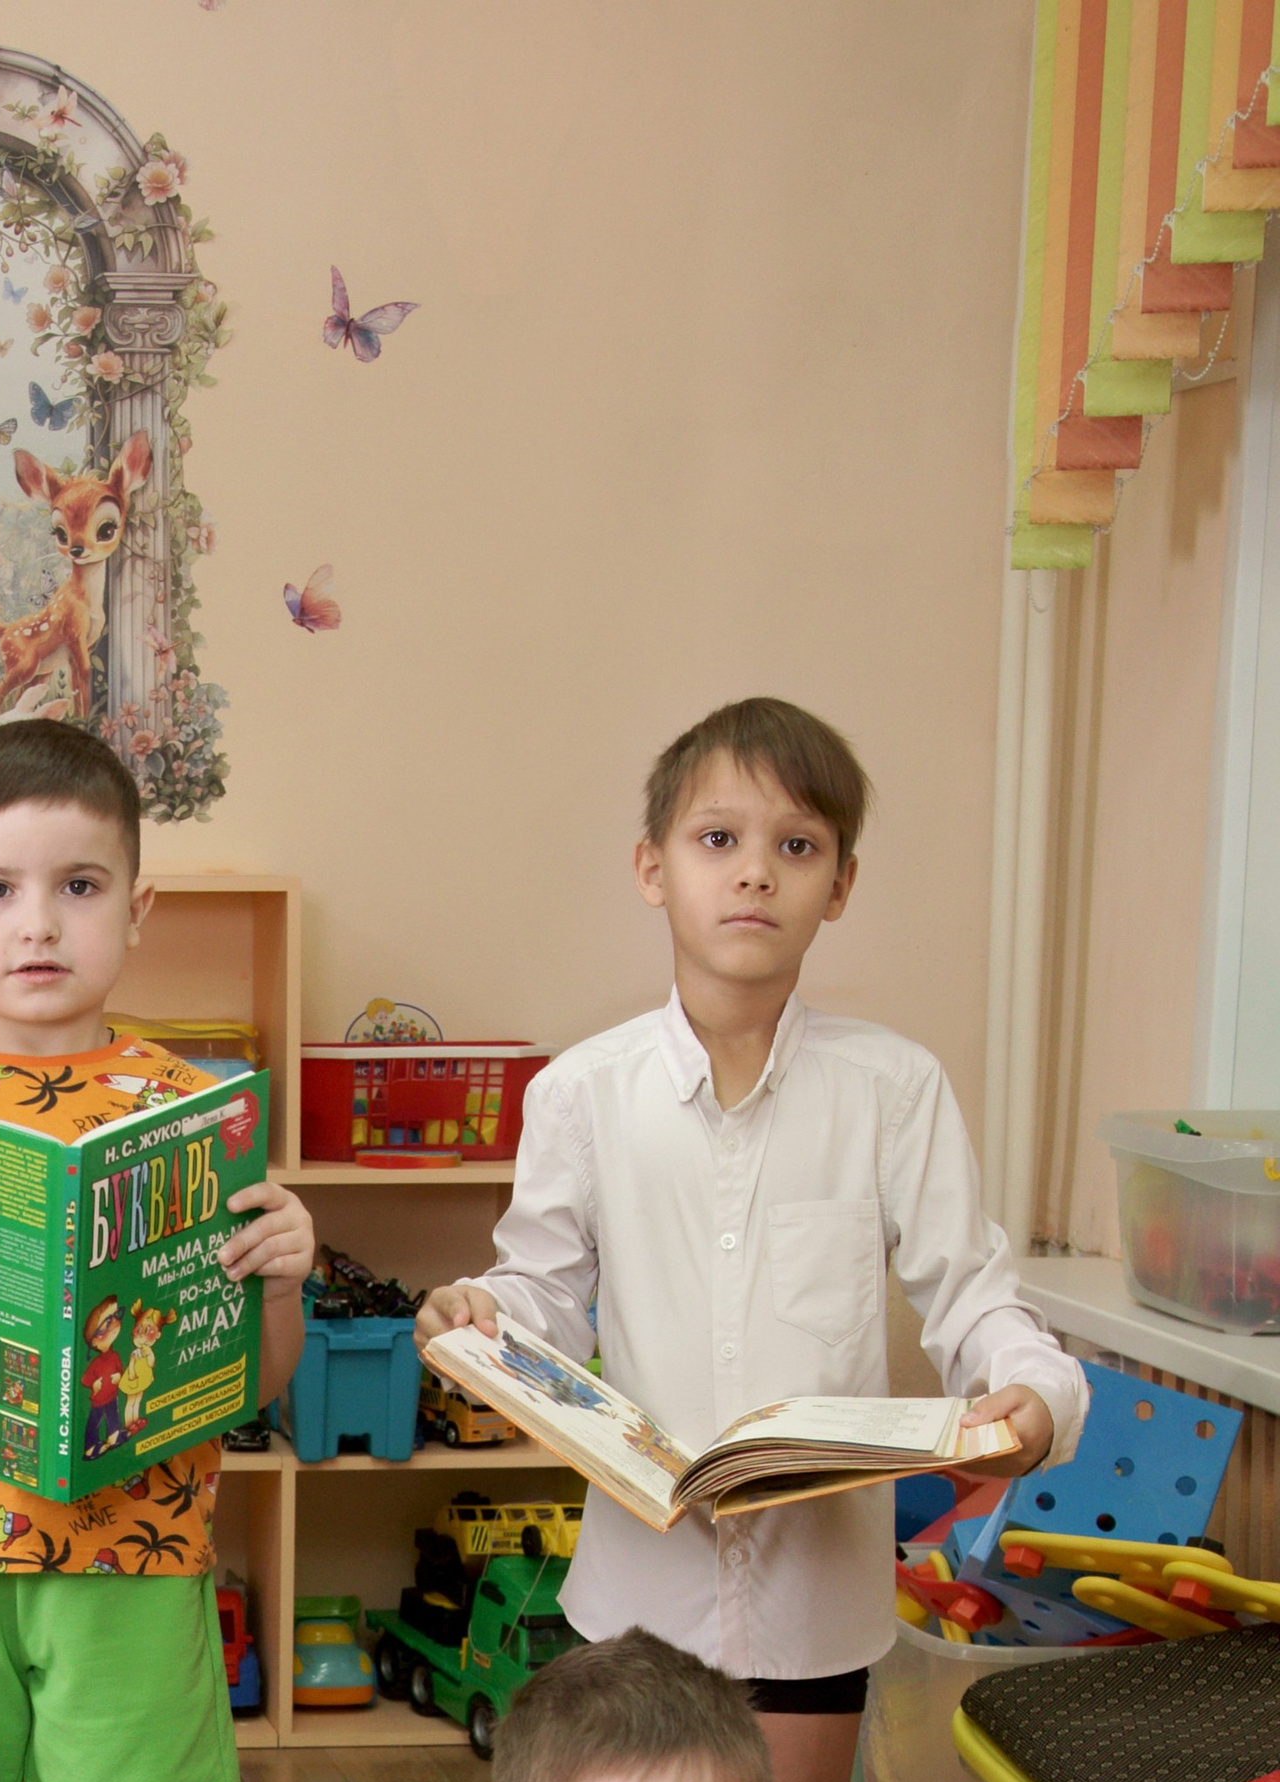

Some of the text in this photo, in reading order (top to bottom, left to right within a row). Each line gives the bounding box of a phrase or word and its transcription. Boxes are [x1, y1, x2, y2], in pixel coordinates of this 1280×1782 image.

[105, 1112, 200, 1166] Н. С. ЖУКО
[89, 1135, 219, 1269] БУКВАРЬ
[63, 1200, 76, 1320] БУКВАРЬ
[142, 1238, 203, 1278] МА-МА
[158, 1262, 196, 1287] МЫ-ЛО
[179, 1276, 244, 1306] РО-ЗА СА
[178, 1297, 246, 1337] АМ АУ
[177, 1335, 221, 1366] ЛУ-НА
[58, 1346, 72, 1455] Н. С. ЖУКОВА
[149, 1361, 243, 1411] СОЧЕТАНИЕ ТРАДИЦИОННОЙ
[188, 1381, 242, 1411] ОРИГИНАЛЬНОЙ
[139, 1400, 241, 1451] ЛОГОПЕДИЧЕСКОЙ МЕТОДИКИ
[68, 1504, 118, 1536] WAVE
